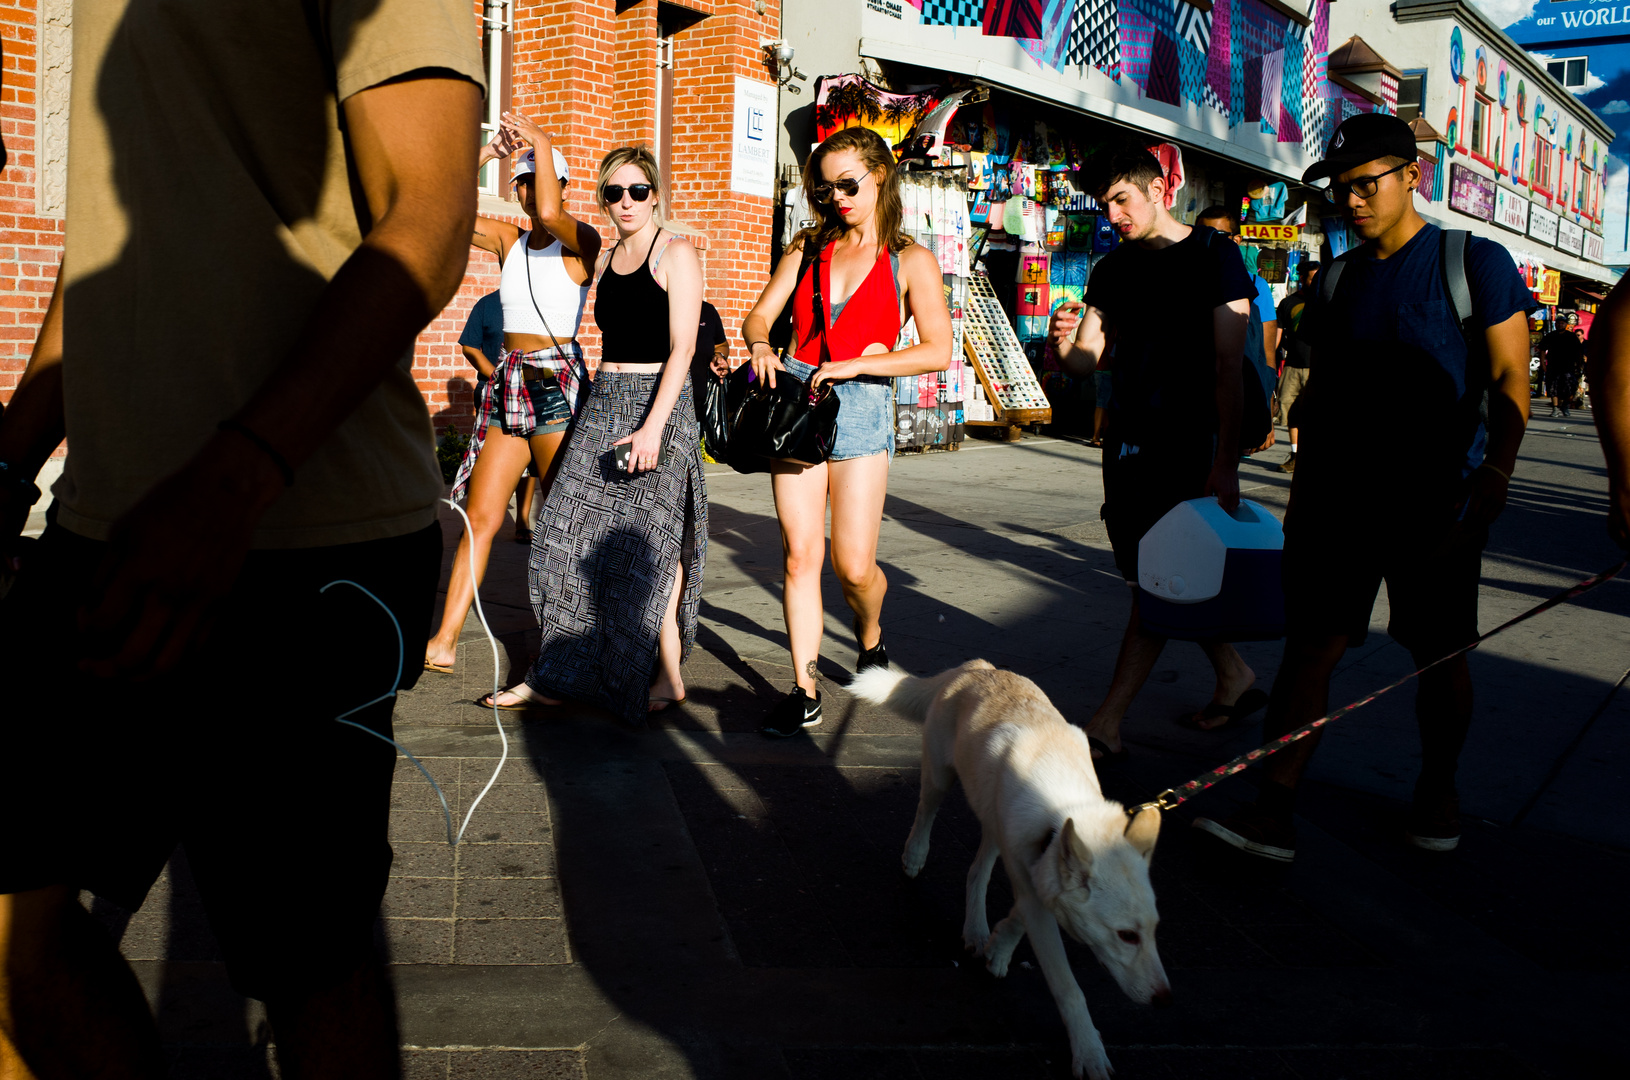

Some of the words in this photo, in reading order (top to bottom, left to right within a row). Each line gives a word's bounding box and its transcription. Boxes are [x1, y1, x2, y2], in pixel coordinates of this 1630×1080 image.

[885, 1, 902, 14] CHASE
[1537, 16, 1556, 26] our
[738, 143, 770, 159] LAMBERT
[1246, 226, 1293, 238] HATS
